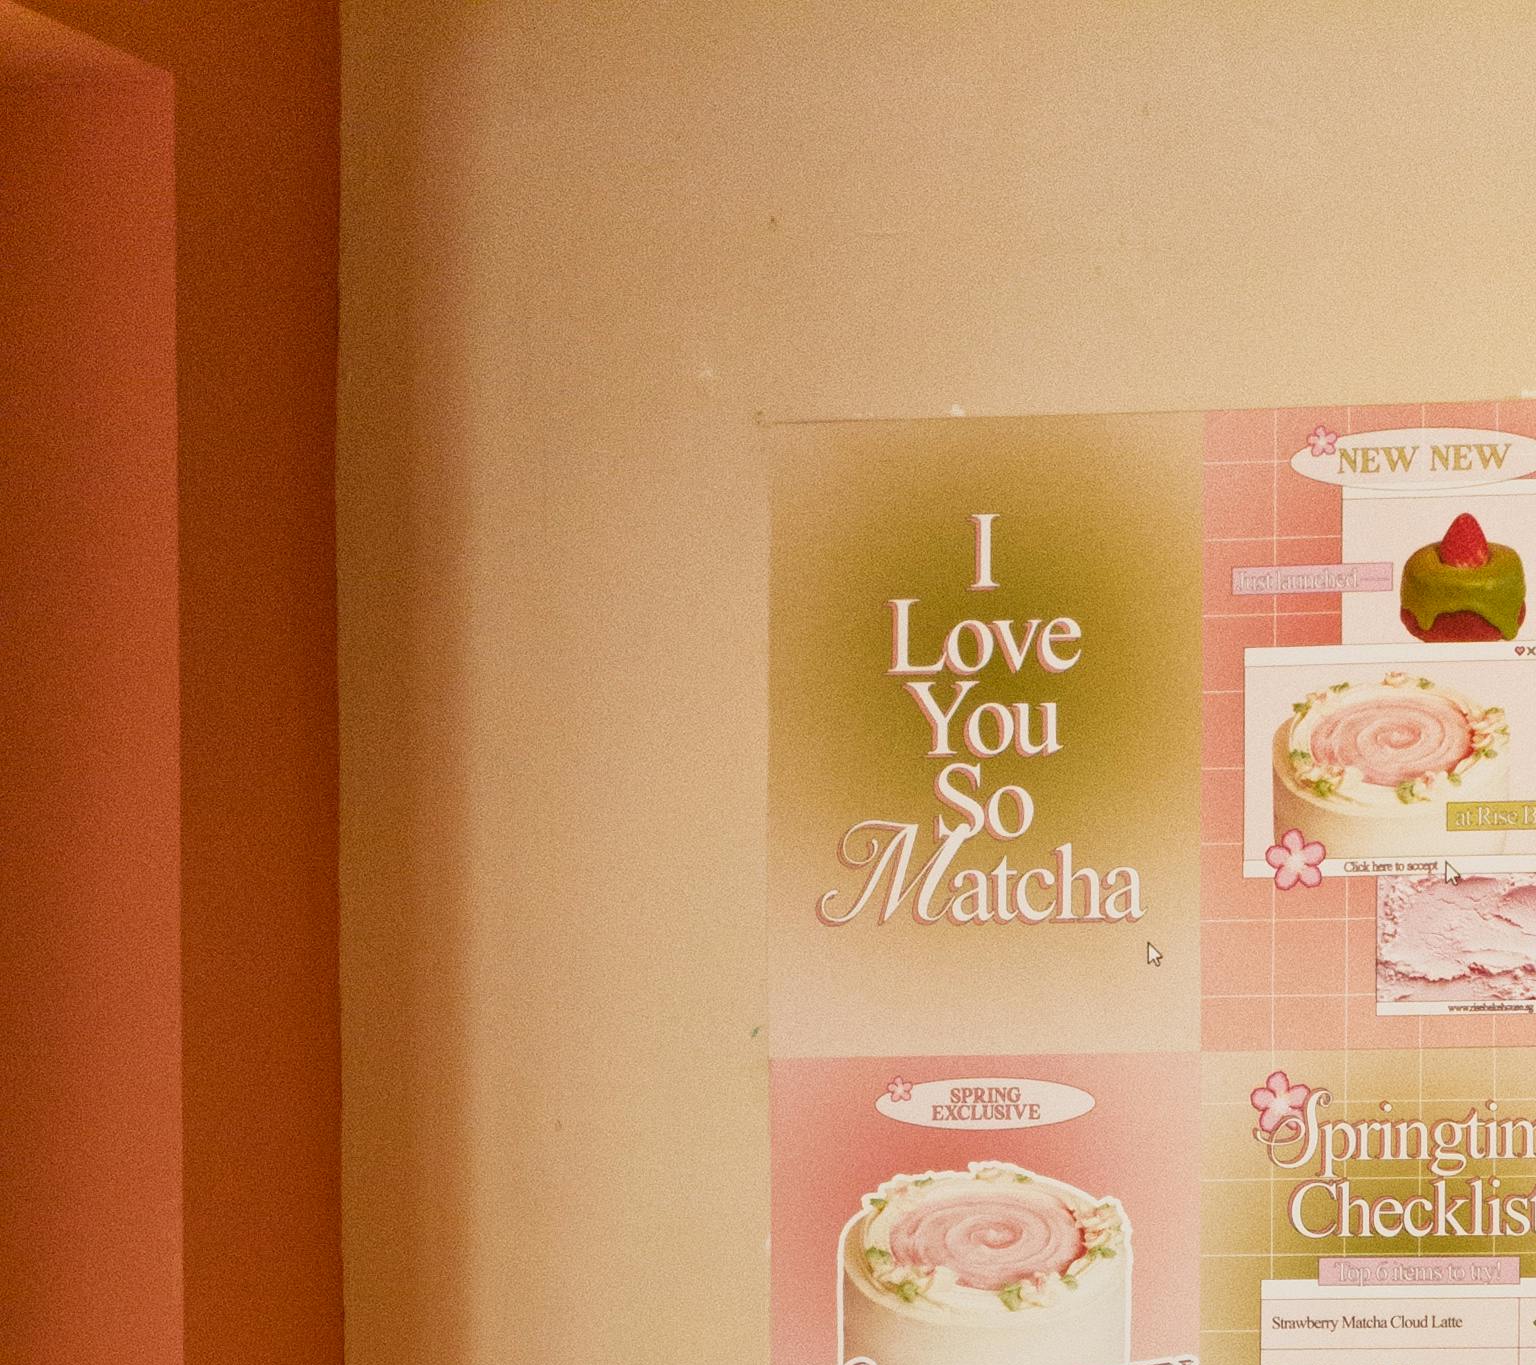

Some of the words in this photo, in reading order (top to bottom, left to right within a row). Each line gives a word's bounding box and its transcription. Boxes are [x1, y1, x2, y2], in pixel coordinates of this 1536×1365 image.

[1337, 445, 1419, 474] NEW
[1429, 443, 1512, 472] NEW
[968, 513, 1000, 591] I
[1236, 571, 1273, 592] Just
[1275, 569, 1359, 591] launched
[885, 599, 1083, 677] Love
[904, 679, 1064, 758] You
[932, 763, 1034, 841] So
[1455, 809, 1472, 826] at
[1478, 806, 1518, 826] Rise
[815, 819, 1149, 928] Matcha
[1344, 861, 1370, 873] Click
[1372, 861, 1393, 872] here
[1395, 862, 1405, 872] to
[950, 1087, 1021, 1103] SPRING
[932, 1104, 1040, 1120] EXCLUSIVE
[1336, 1261, 1372, 1286] Top
[1375, 1260, 1388, 1281] 6
[1390, 1261, 1442, 1281] items
[1447, 1263, 1466, 1281] to
[1471, 1261, 1502, 1285] try!
[1272, 1316, 1338, 1332] Strawberry
[1342, 1315, 1387, 1328] Matcha
[1390, 1315, 1428, 1328] Cloud
[1432, 1315, 1463, 1328] Latte
